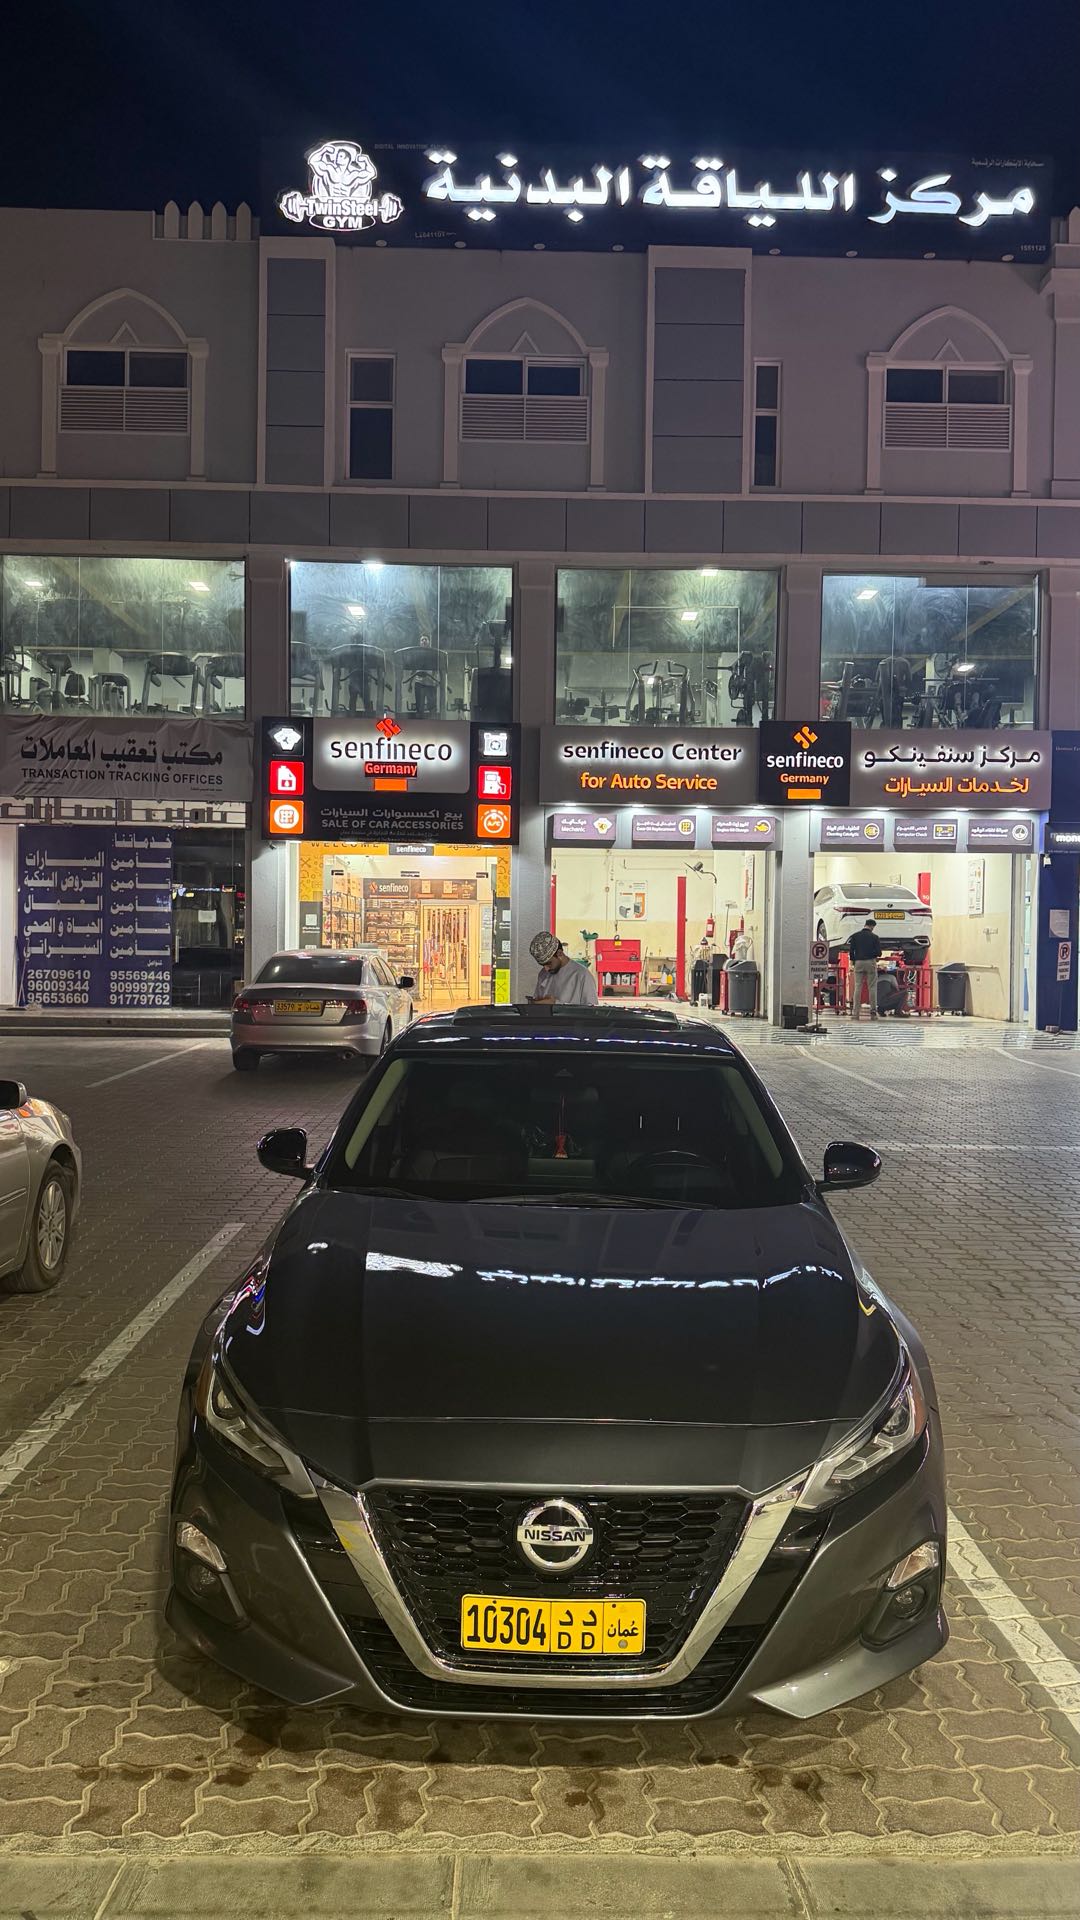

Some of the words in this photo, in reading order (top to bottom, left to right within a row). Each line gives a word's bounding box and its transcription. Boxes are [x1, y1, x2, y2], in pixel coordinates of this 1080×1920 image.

[425, 150, 631, 223] البدنية
[641, 155, 856, 228] اللياقة
[306, 198, 378, 217] TwinSteel
[868, 168, 1036, 228] مركز
[322, 215, 363, 229] GYM
[20, 736, 96, 762] المعاملات
[100, 738, 158, 770] تعقيب
[162, 742, 223, 771] مكتب
[330, 736, 453, 762] senfineco
[563, 740, 664, 760] senfineco
[672, 743, 742, 762] Center
[864, 744, 974, 768] سنفينكو
[980, 746, 1041, 768] مركز
[365, 762, 418, 776] Germany
[766, 752, 844, 768] senfineco
[22, 768, 105, 780] TRANSACTION
[108, 770, 170, 784] TRACKING
[172, 773, 223, 786] OFFICES
[580, 772, 606, 788] for
[610, 774, 652, 790] Auto
[655, 774, 718, 790] Service
[780, 774, 830, 786] Germany
[957, 776, 1030, 794] لخدمات
[884, 776, 952, 798] السيارات
[320, 807, 368, 819] السيارات
[372, 808, 440, 820] اكسسوارات
[443, 810, 463, 822] بيع
[322, 819, 348, 828] SALE
[351, 820, 366, 828] OF
[396, 845, 427, 854] senfineco
[26, 850, 105, 871] السيارات
[110, 852, 172, 871] تأمين
[24, 870, 58, 892] البنكية
[60, 872, 103, 892] القروض
[110, 873, 172, 893] تأمين
[379, 883, 409, 893] senfineco
[24, 894, 103, 914] العمال
[58, 920, 64, 937] و
[67, 918, 103, 937] الحياة
[110, 918, 171, 937] تأمين
[110, 940, 171, 959] تأمين
[27, 969, 91, 980] 26709610
[110, 970, 170, 981] 95569446
[27, 980, 90, 992] 96009344
[110, 982, 170, 993] 90999729
[27, 992, 90, 1004] 95653660
[110, 994, 170, 1005] 91779762
[524, 1528, 586, 1542] NISSAN
[467, 1604, 546, 1646] 10304
